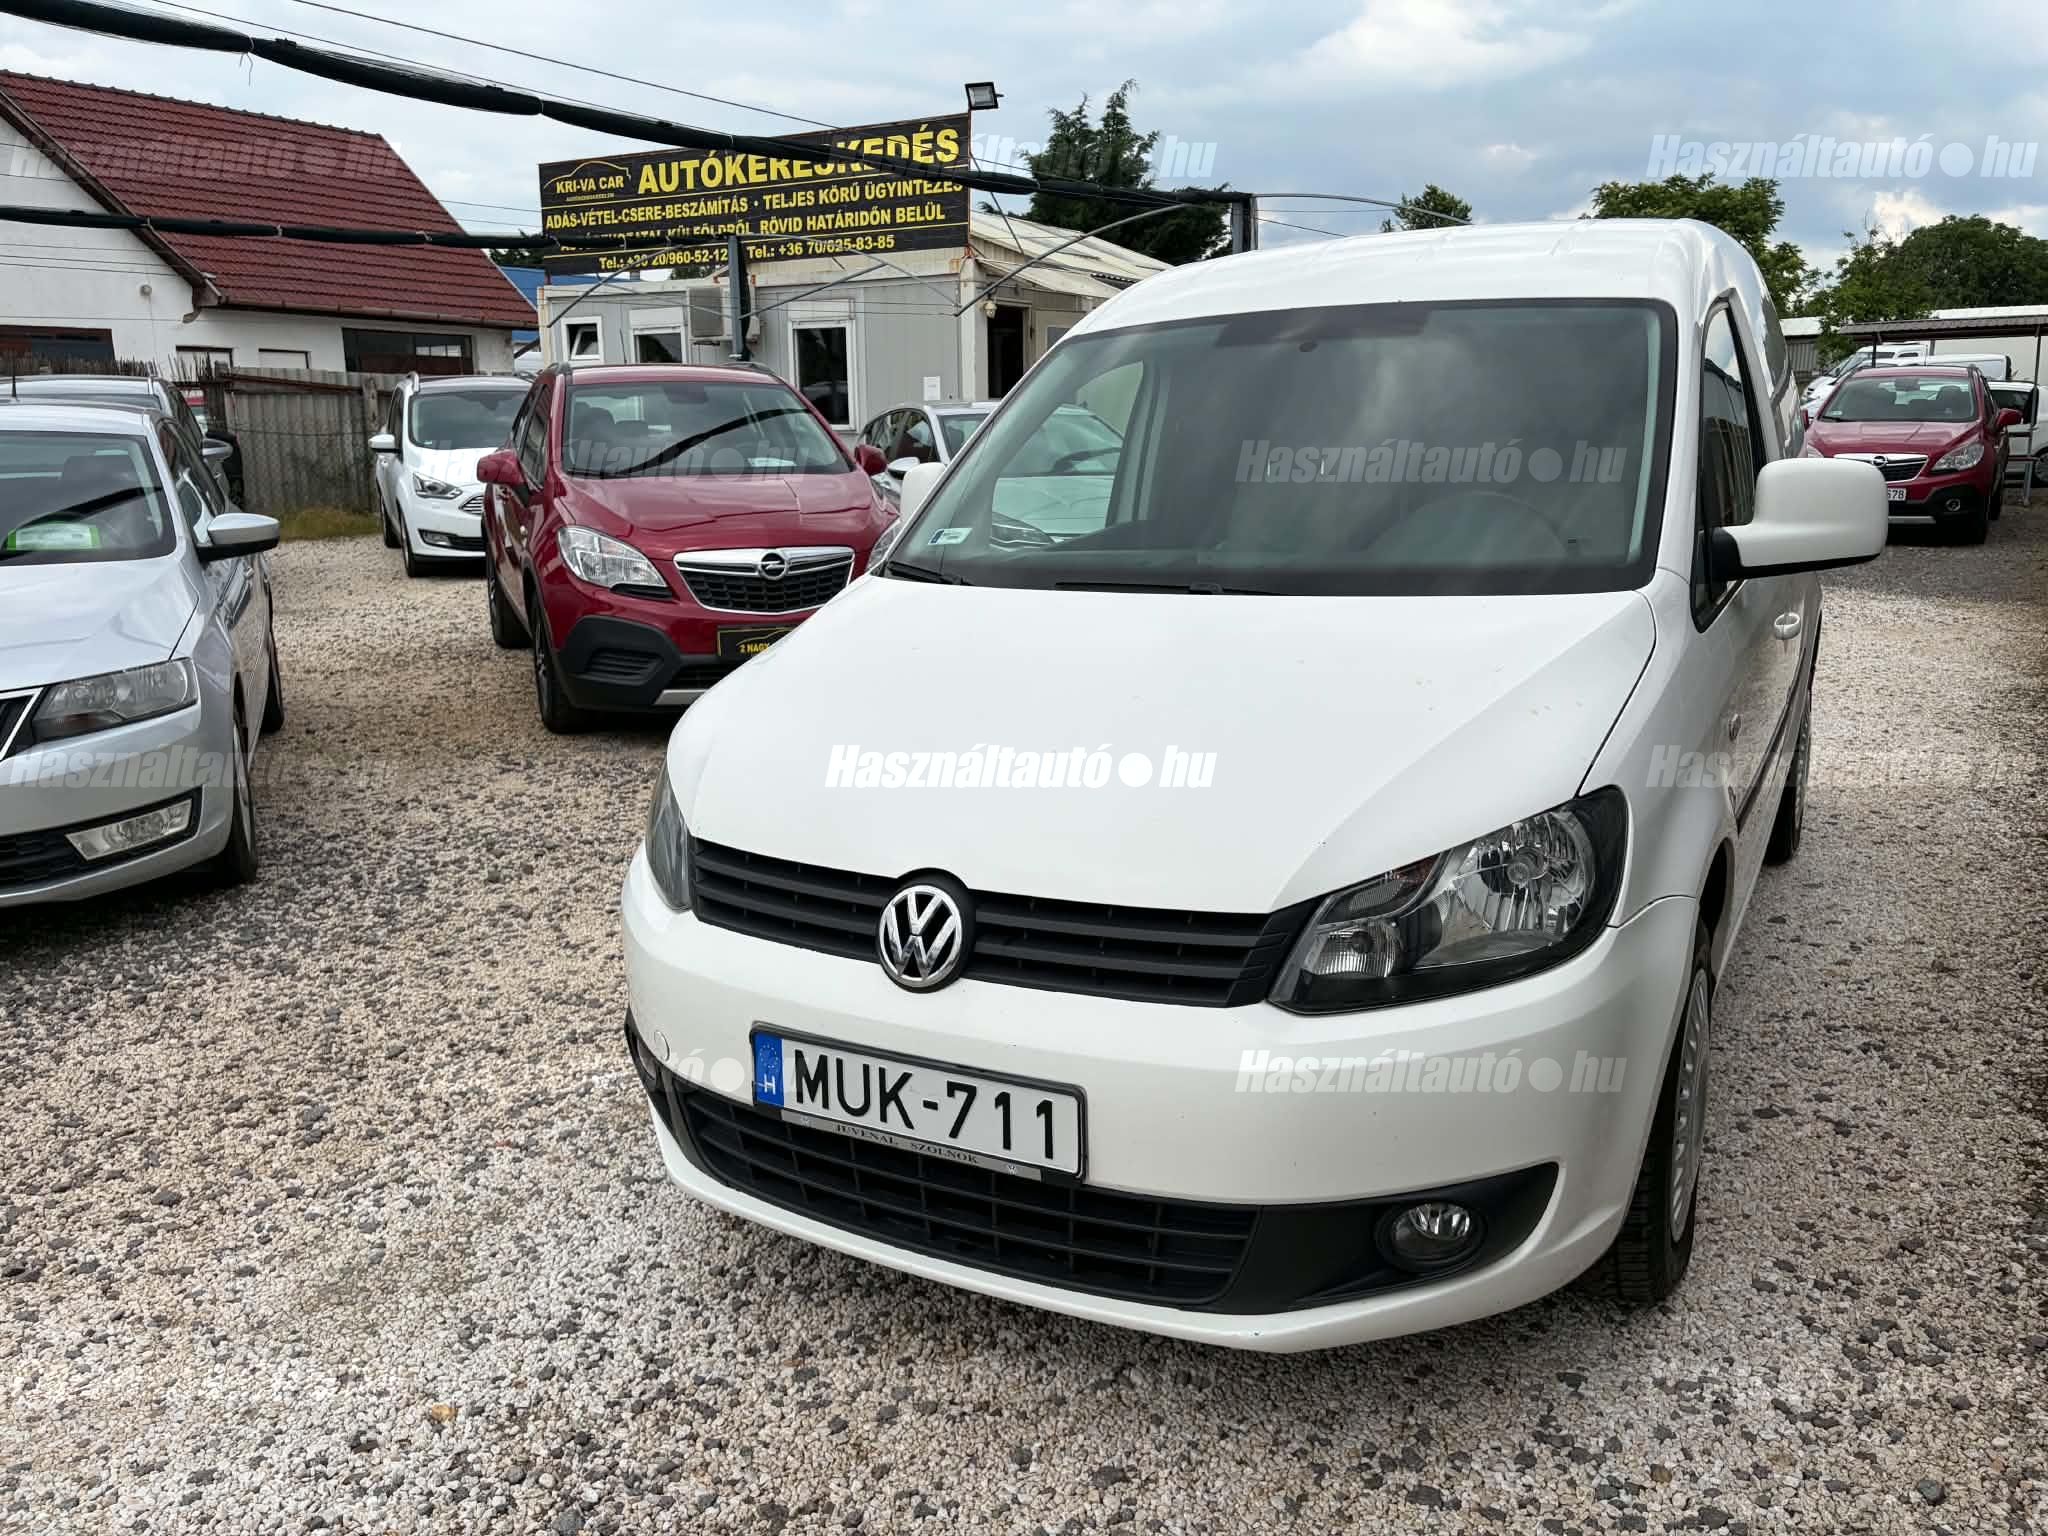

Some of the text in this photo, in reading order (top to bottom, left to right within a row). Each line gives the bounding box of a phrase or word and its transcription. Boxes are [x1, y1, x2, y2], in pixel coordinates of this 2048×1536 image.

[556, 175, 625, 194] KRI-VA CAR
[762, 190, 815, 210] TELJES
[819, 181, 860, 205] KÖRŰ
[760, 215, 803, 235] RÖVID
[806, 206, 891, 231] HATÁRIDŐN
[896, 201, 946, 224] BELÜL
[746, 245, 775, 259] Tel.:
[778, 242, 803, 256] +36
[763, 1074, 776, 1096] H
[794, 1049, 1054, 1161] MUK-711
[911, 1143, 979, 1164] SZOLNOK
